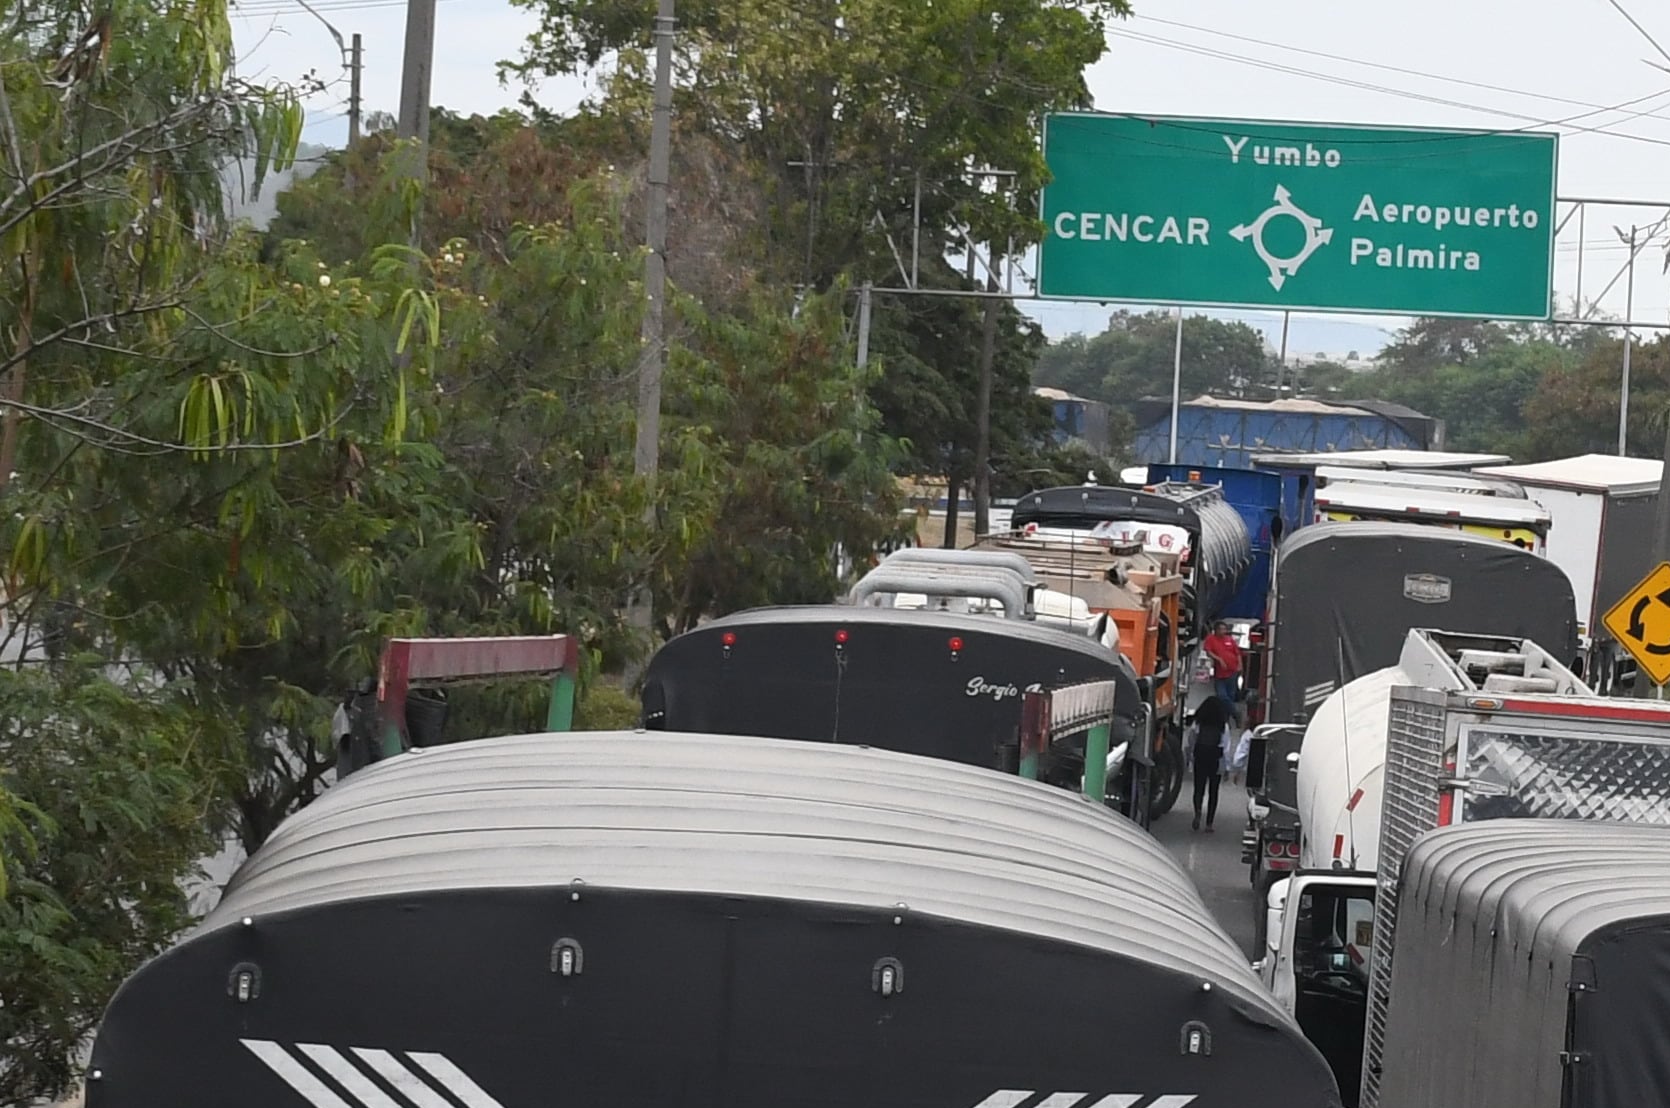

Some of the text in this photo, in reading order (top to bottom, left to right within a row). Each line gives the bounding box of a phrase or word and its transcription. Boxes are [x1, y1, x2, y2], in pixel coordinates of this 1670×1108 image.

[1222, 135, 1341, 168] Yumbo
[1353, 193, 1538, 230] Aeropuerto
[1054, 212, 1210, 246] CENCAR
[1350, 237, 1481, 272] Palmira
[965, 676, 1018, 701] Sergio
